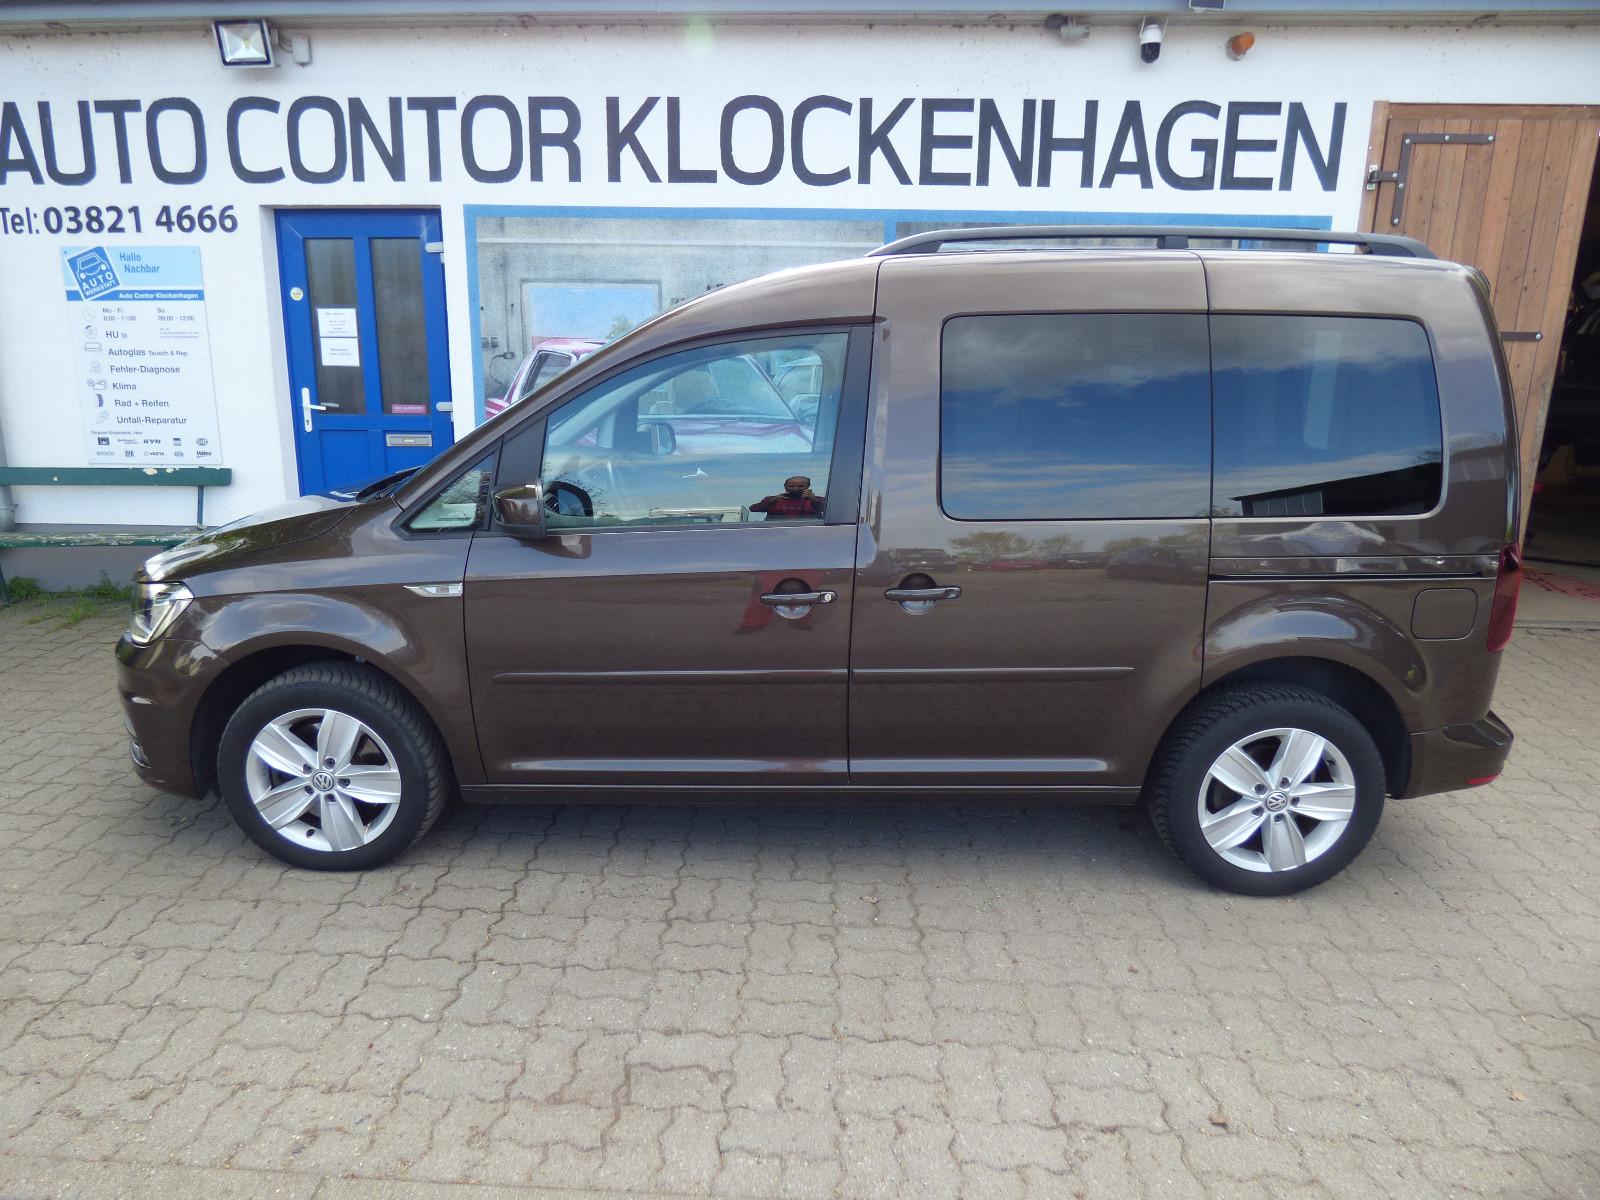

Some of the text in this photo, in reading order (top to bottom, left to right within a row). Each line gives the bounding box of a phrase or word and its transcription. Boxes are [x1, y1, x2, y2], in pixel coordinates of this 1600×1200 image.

[0, 94, 1347, 192] AUTO CONTOR KLOCKENHAGEN
[0, 204, 239, 235] Tel: 03821 4666
[119, 253, 142, 262] Hallo
[124, 264, 160, 273] Nachbar
[82, 272, 114, 292] AUTO
[84, 280, 116, 297] WERKSTATT
[156, 292, 199, 300] Klockenhagen
[105, 330, 119, 339] HU
[108, 348, 146, 357] Autoglas
[110, 365, 180, 374] Fehler-Diagnose
[112, 382, 137, 390] Klima
[114, 399, 132, 407] Rad
[141, 399, 169, 407] Reifen
[116, 416, 187, 425] Unfall-Reparatur
